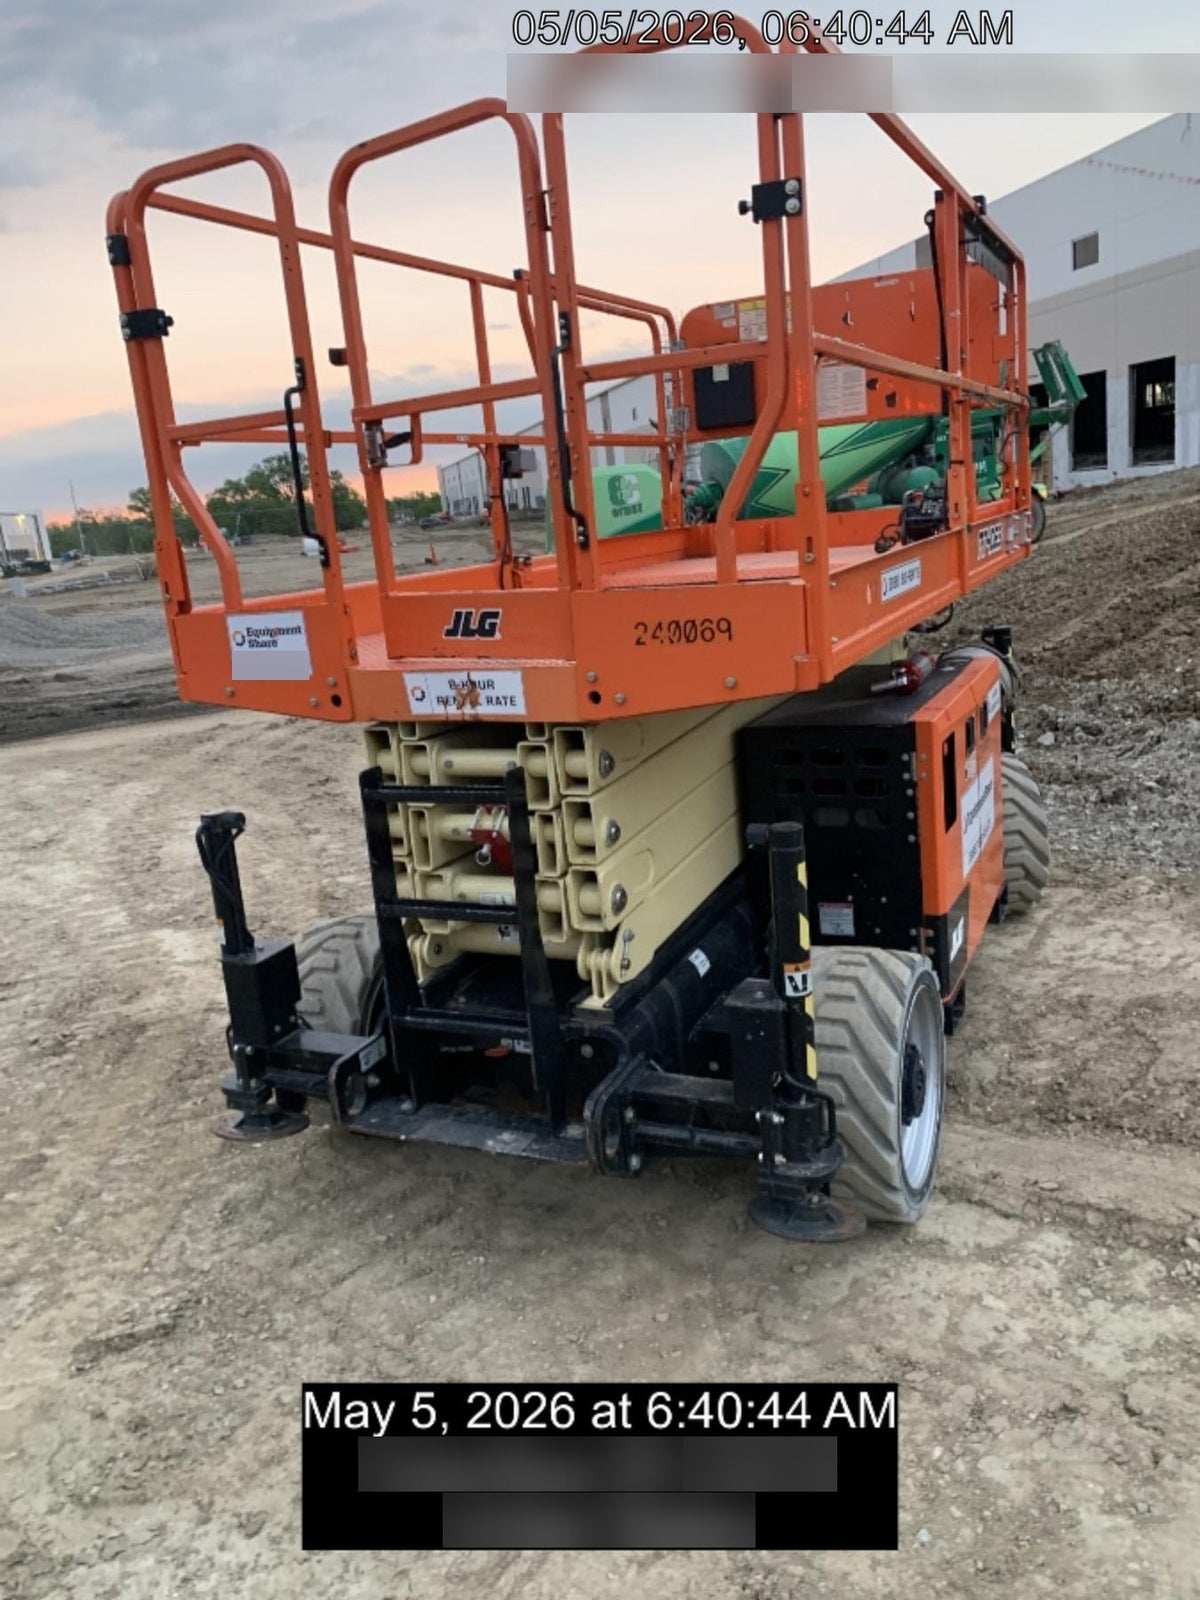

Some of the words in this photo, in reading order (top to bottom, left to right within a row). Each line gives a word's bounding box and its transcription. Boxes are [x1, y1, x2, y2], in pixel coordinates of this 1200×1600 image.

[444, 610, 501, 638] JLG
[634, 617, 732, 646] 240069
[485, 695, 517, 707] RATE
